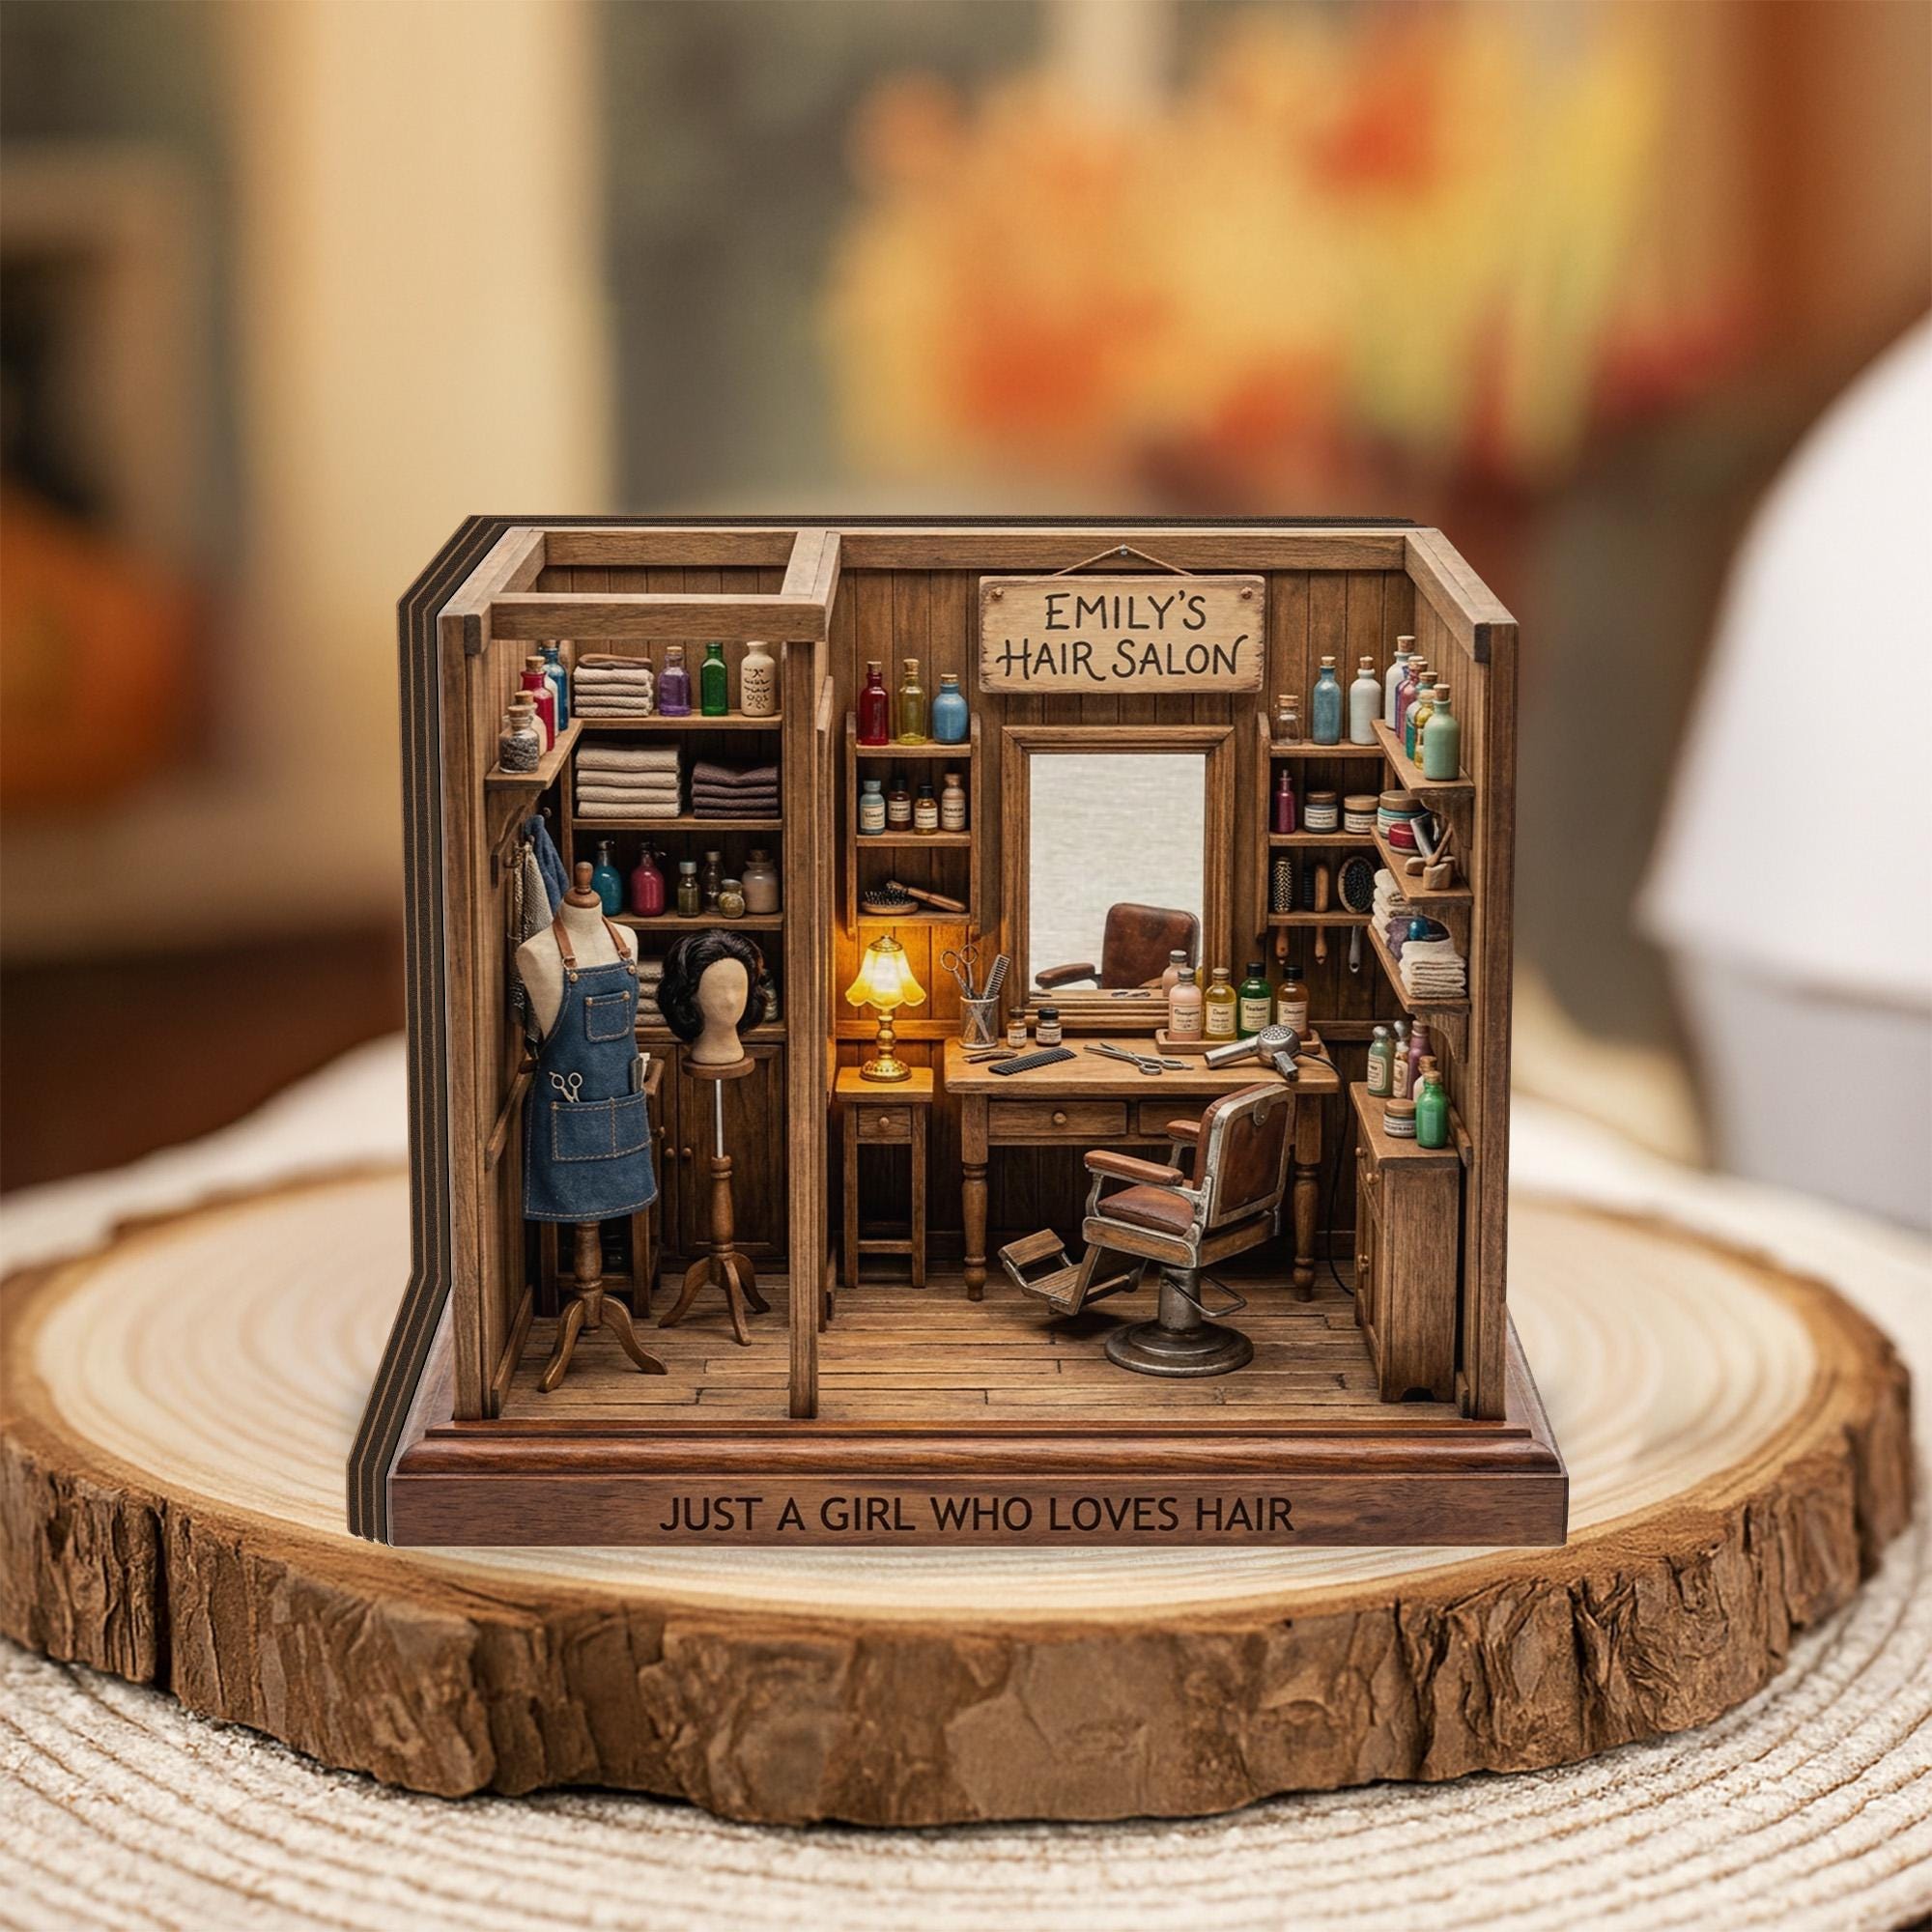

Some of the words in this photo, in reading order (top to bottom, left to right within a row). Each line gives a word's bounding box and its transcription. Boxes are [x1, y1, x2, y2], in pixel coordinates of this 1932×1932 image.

[1044, 589, 1207, 631] EMILY'S
[995, 638, 1107, 681] HAIR
[1111, 634, 1249, 679] SALON
[659, 1496, 763, 1531] JUST
[776, 1497, 806, 1531] A
[820, 1496, 916, 1531] GIRL
[929, 1496, 1033, 1531] WHO
[1049, 1496, 1179, 1532] LOVES
[1196, 1496, 1294, 1531] HAIR
